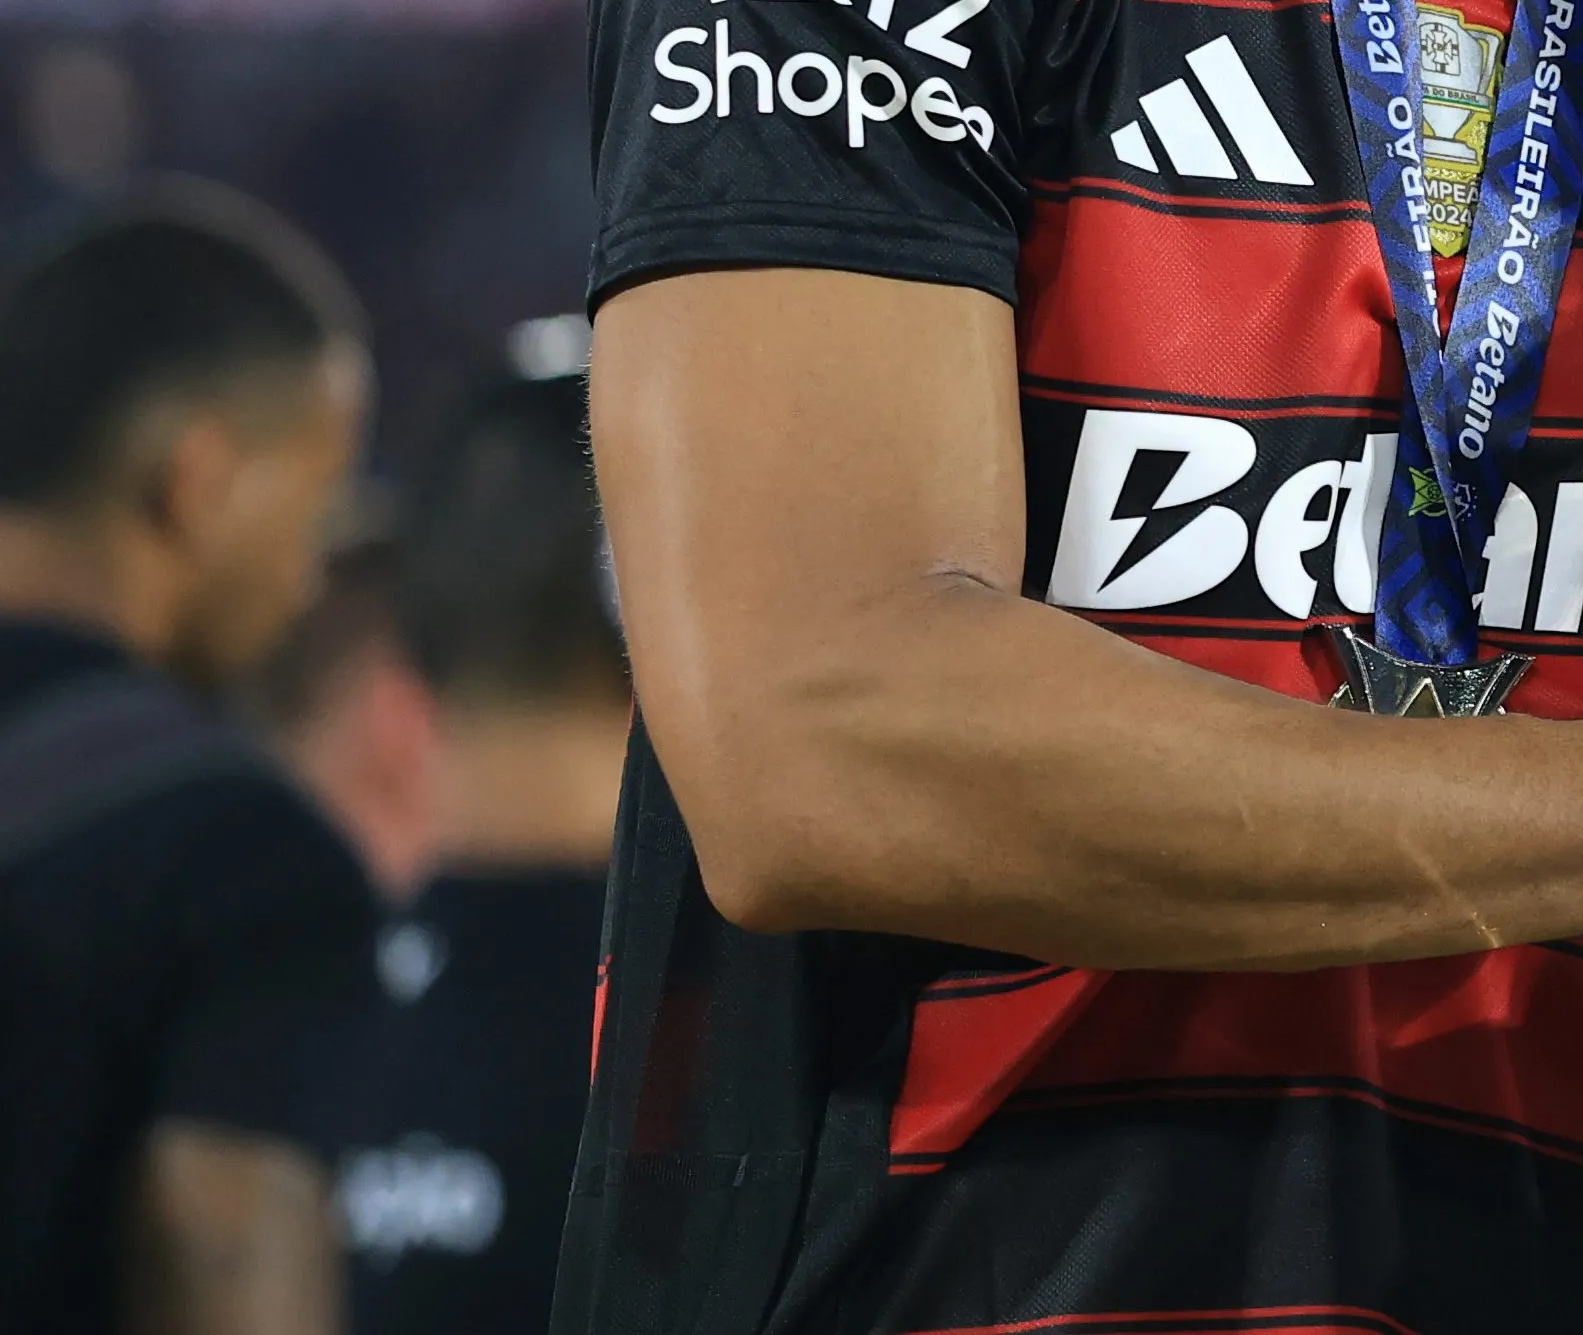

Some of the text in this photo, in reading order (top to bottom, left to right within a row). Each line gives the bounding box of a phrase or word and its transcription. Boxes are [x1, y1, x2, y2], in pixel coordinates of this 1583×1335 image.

[1424, 177, 1481, 204] MPEÃ
[1425, 204, 1472, 226] 2024
[1457, 300, 1521, 460] Betano
